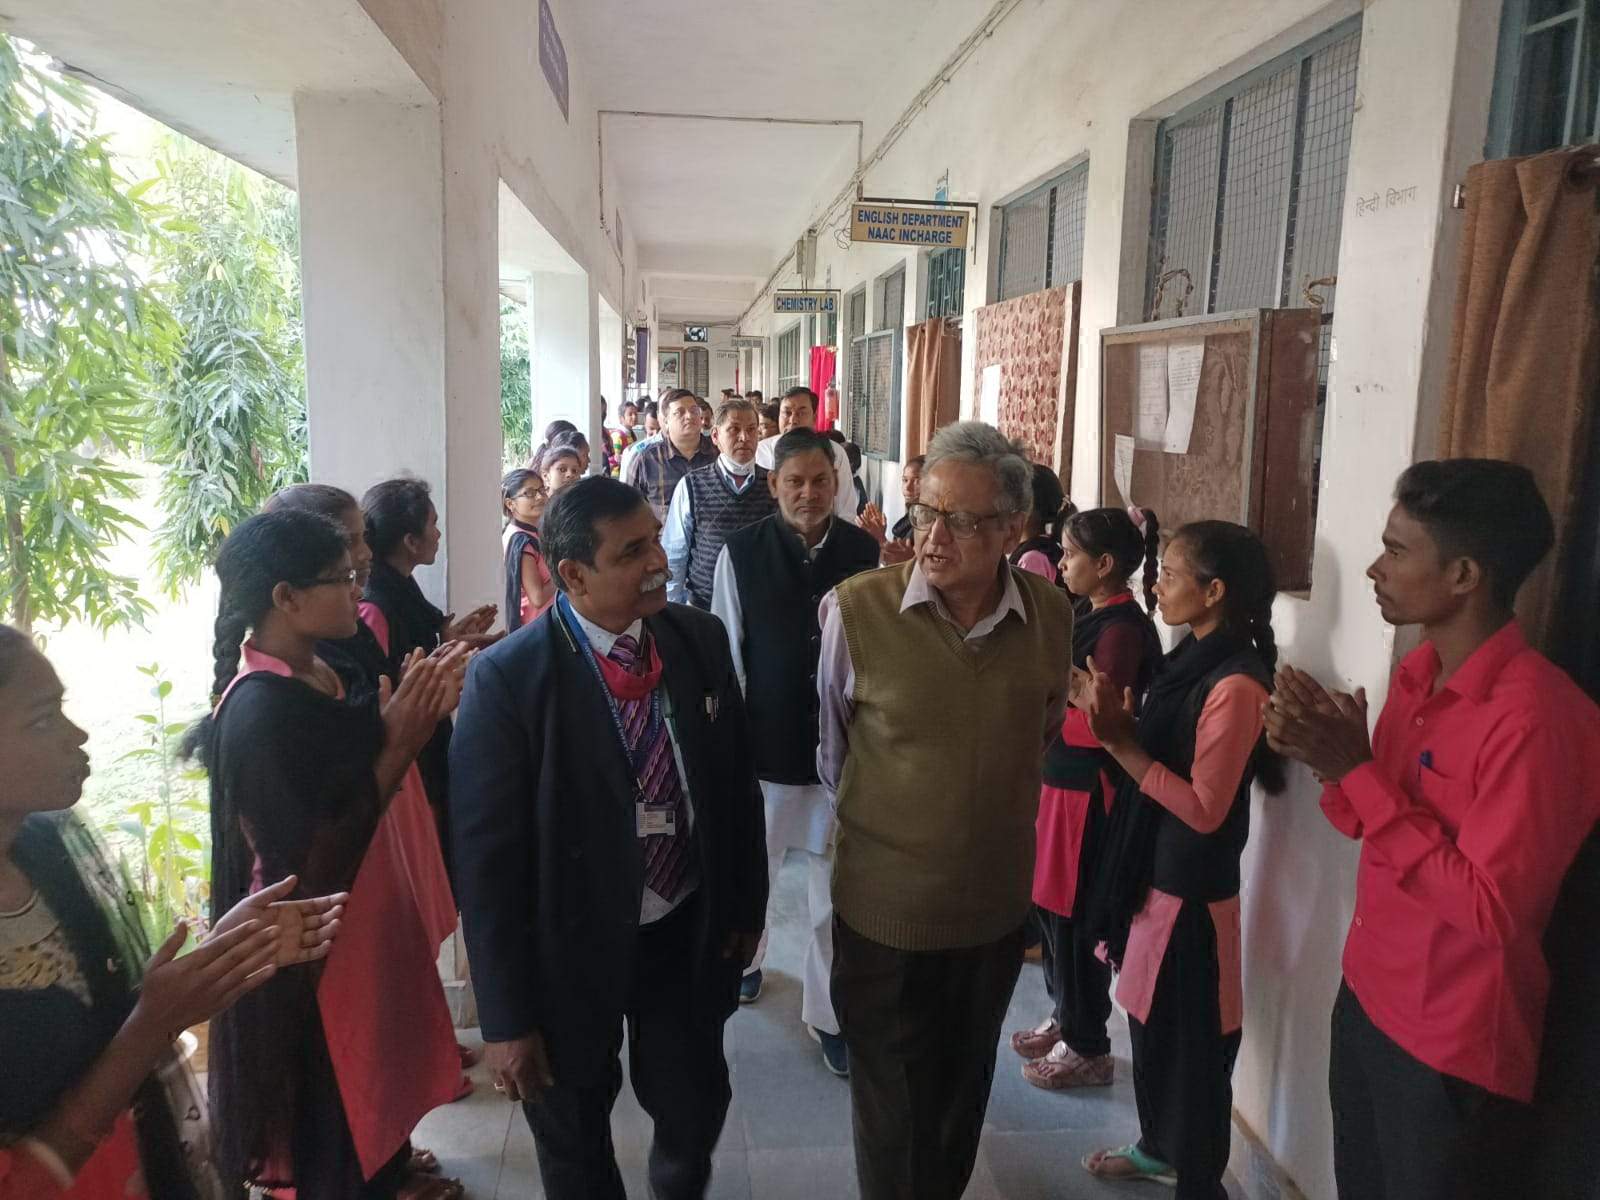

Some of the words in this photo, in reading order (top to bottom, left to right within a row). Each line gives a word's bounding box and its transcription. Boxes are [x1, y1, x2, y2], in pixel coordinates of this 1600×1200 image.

[858, 210, 898, 224] ENGLISH
[902, 213, 964, 228] DEPARTMENT
[867, 227, 896, 240] NAAC
[899, 228, 952, 243] INCHARGE
[776, 297, 817, 311] CHEMISTRY
[820, 298, 834, 311] LAB
